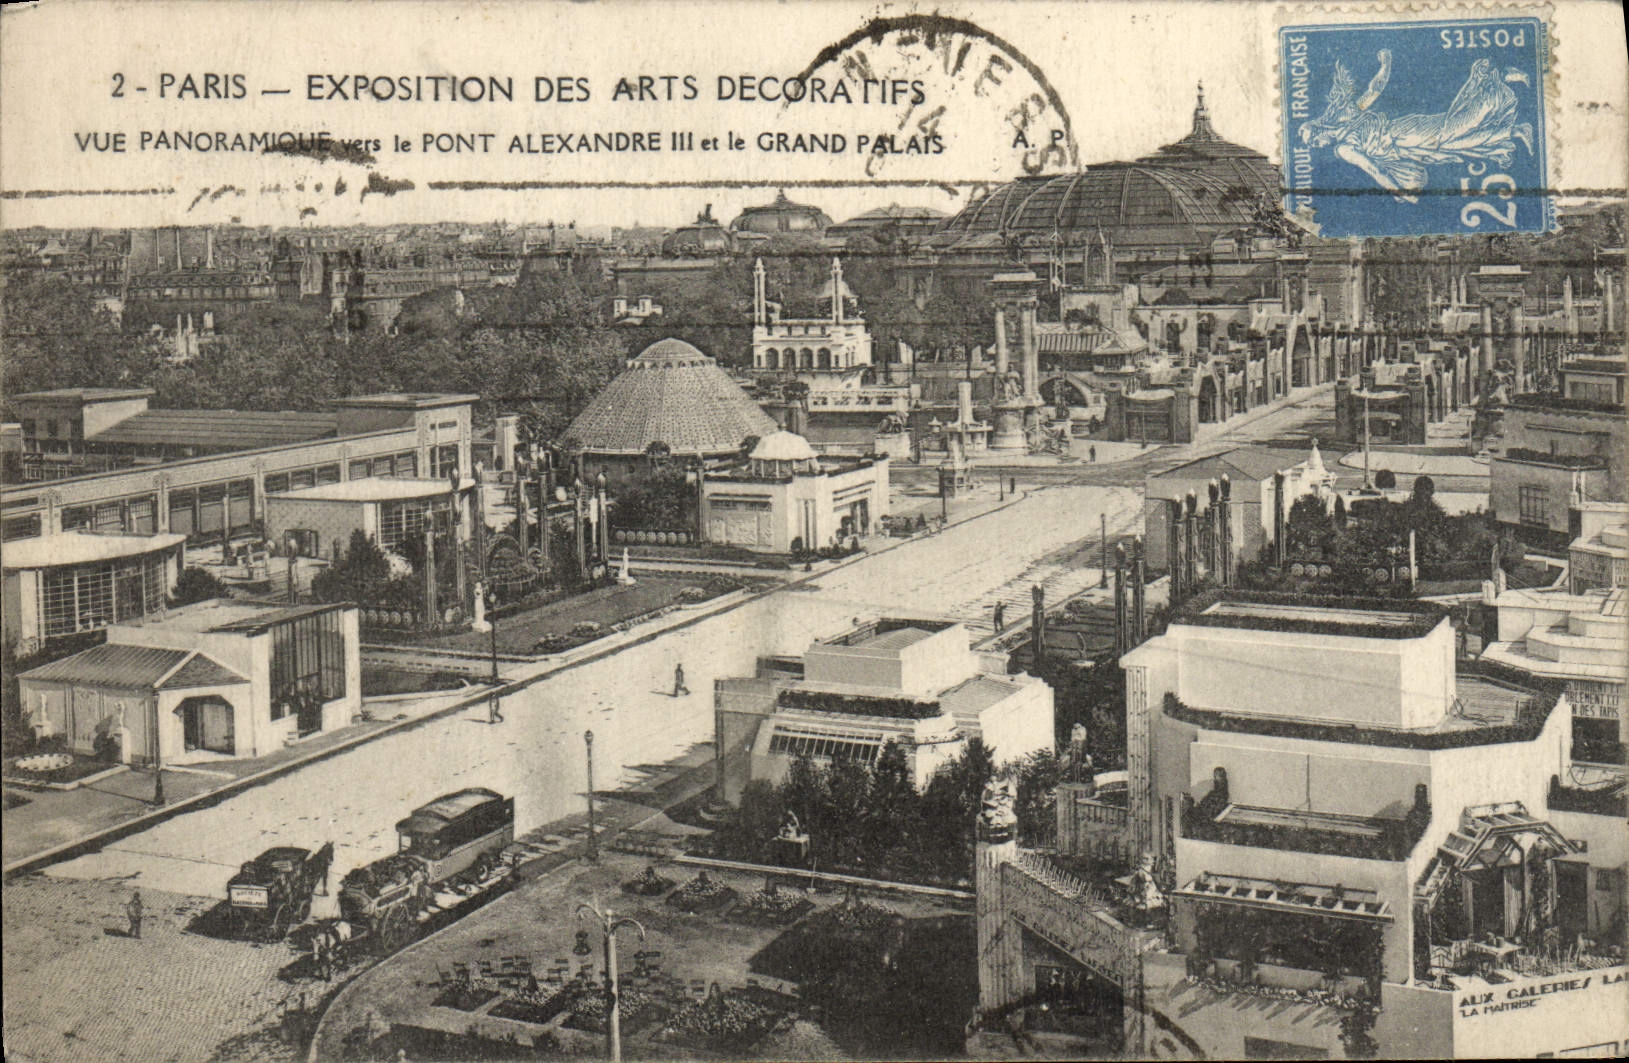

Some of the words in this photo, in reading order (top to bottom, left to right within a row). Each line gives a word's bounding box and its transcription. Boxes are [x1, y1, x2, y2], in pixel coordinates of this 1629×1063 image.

[1440, 28, 1525, 49] POSTES
[1288, 35, 1310, 119] FRANÇAISE
[1459, 992, 1494, 1007] AUX
[1506, 976, 1592, 1000] GALERIES
